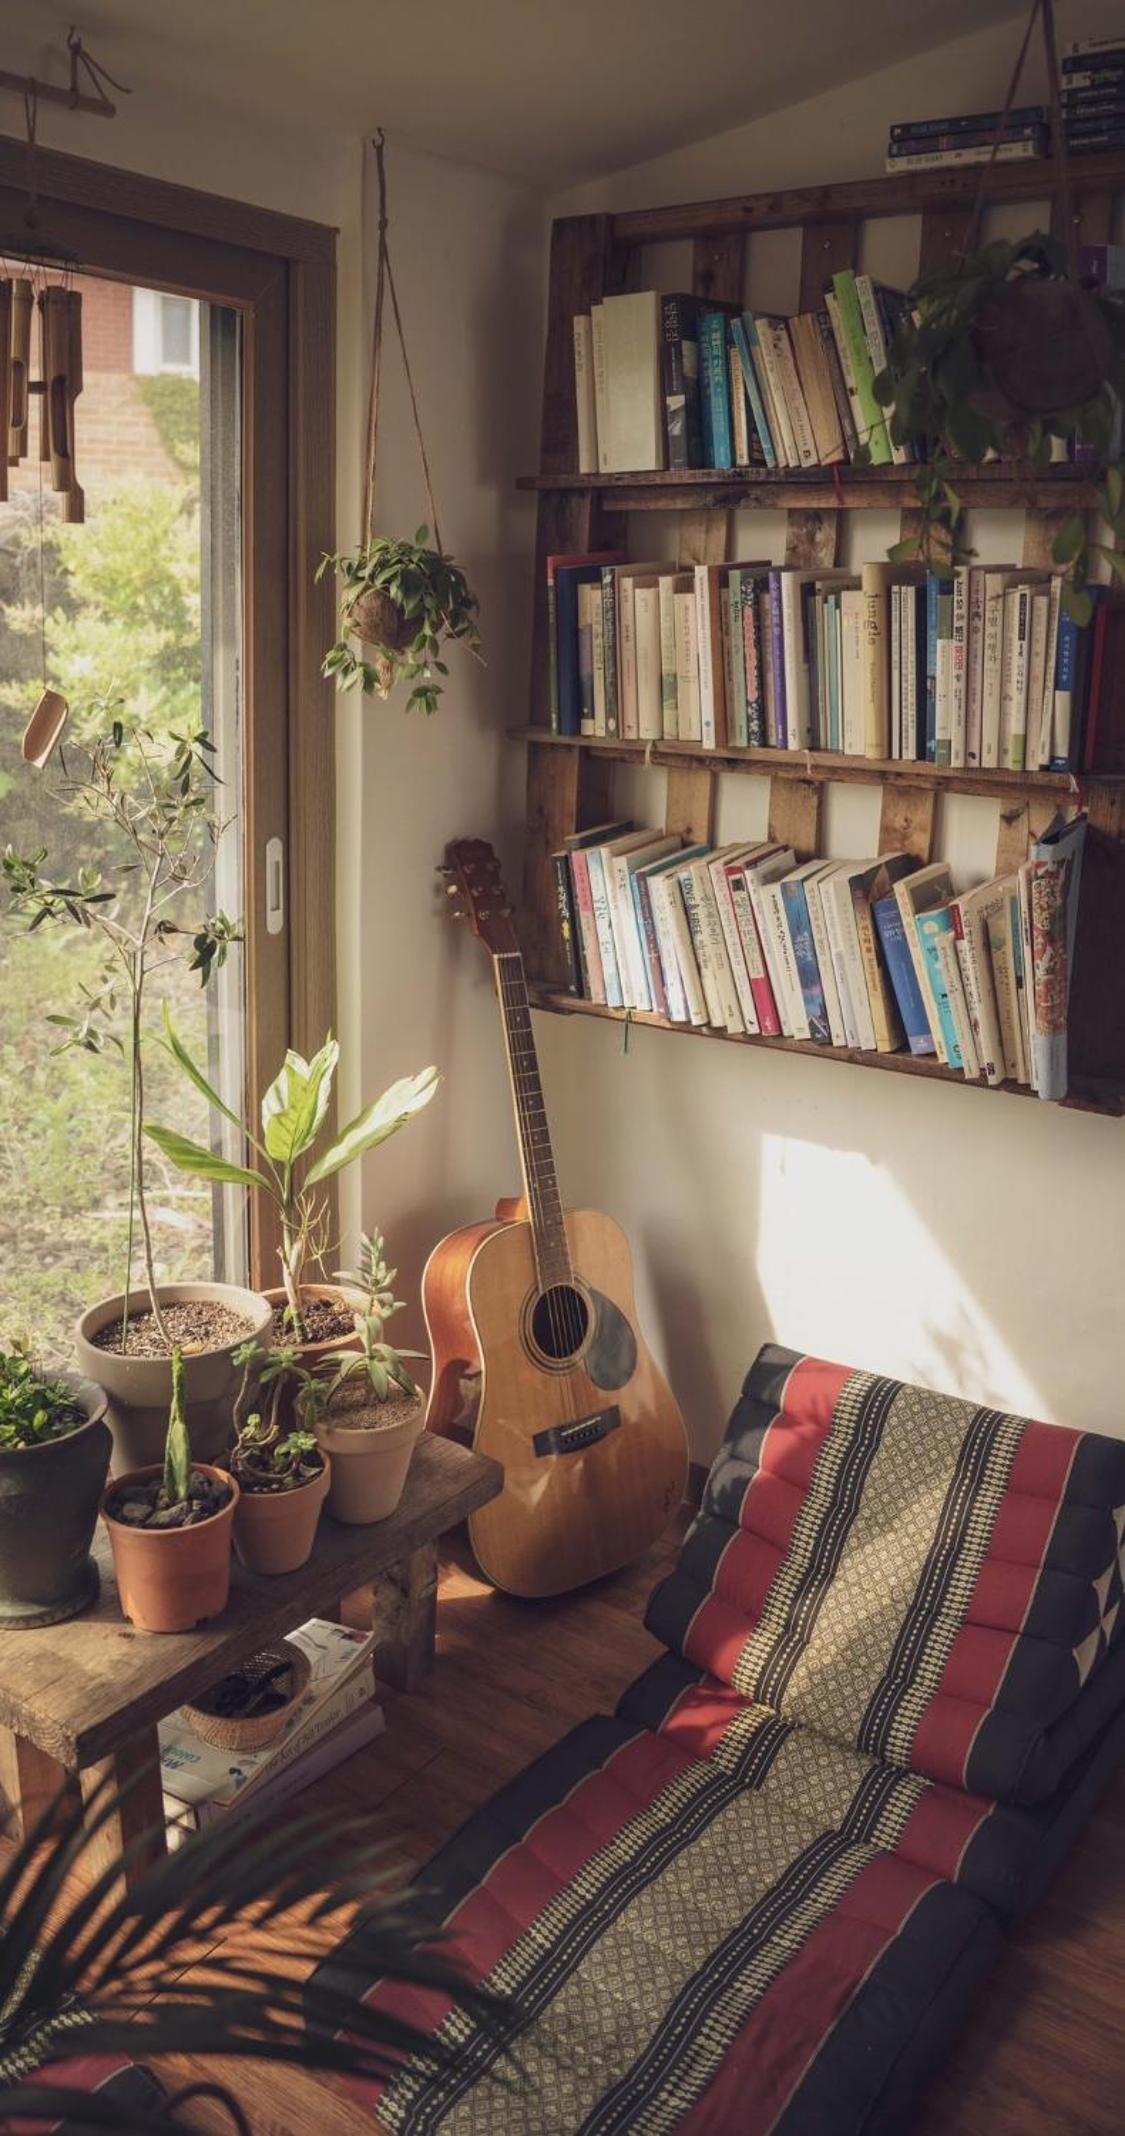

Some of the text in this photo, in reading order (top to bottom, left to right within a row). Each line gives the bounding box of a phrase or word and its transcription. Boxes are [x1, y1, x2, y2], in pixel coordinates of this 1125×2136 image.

[864, 592, 881, 645] Jungle
[683, 878, 696, 904] LOVE
[689, 912, 703, 935] FREE
